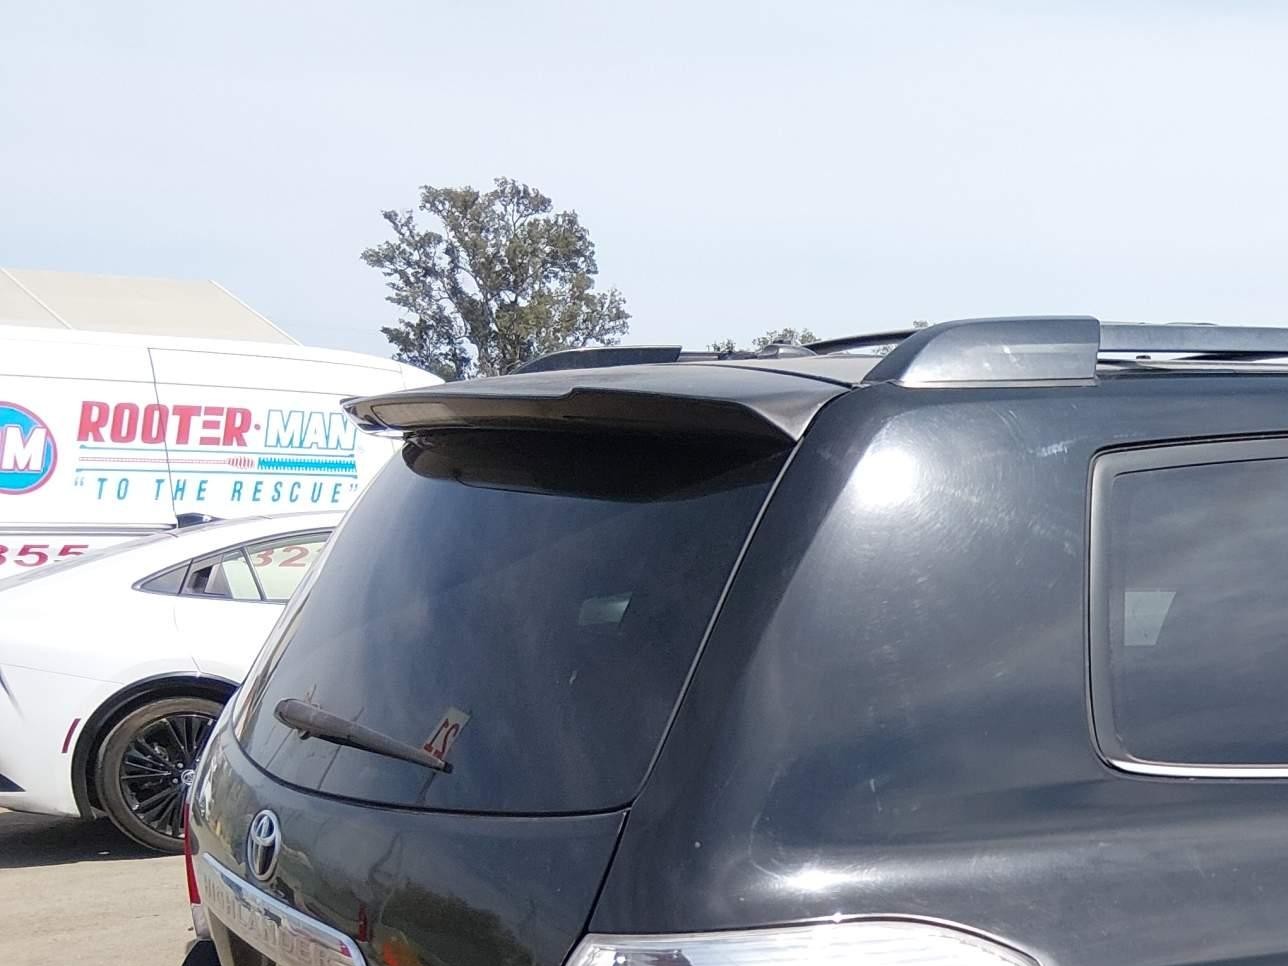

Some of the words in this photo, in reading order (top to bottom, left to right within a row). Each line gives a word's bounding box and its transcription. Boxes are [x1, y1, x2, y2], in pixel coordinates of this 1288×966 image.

[0, 424, 47, 474] M
[154, 478, 209, 502] THE
[0, 544, 89, 568] 55
[252, 546, 322, 568] 32
